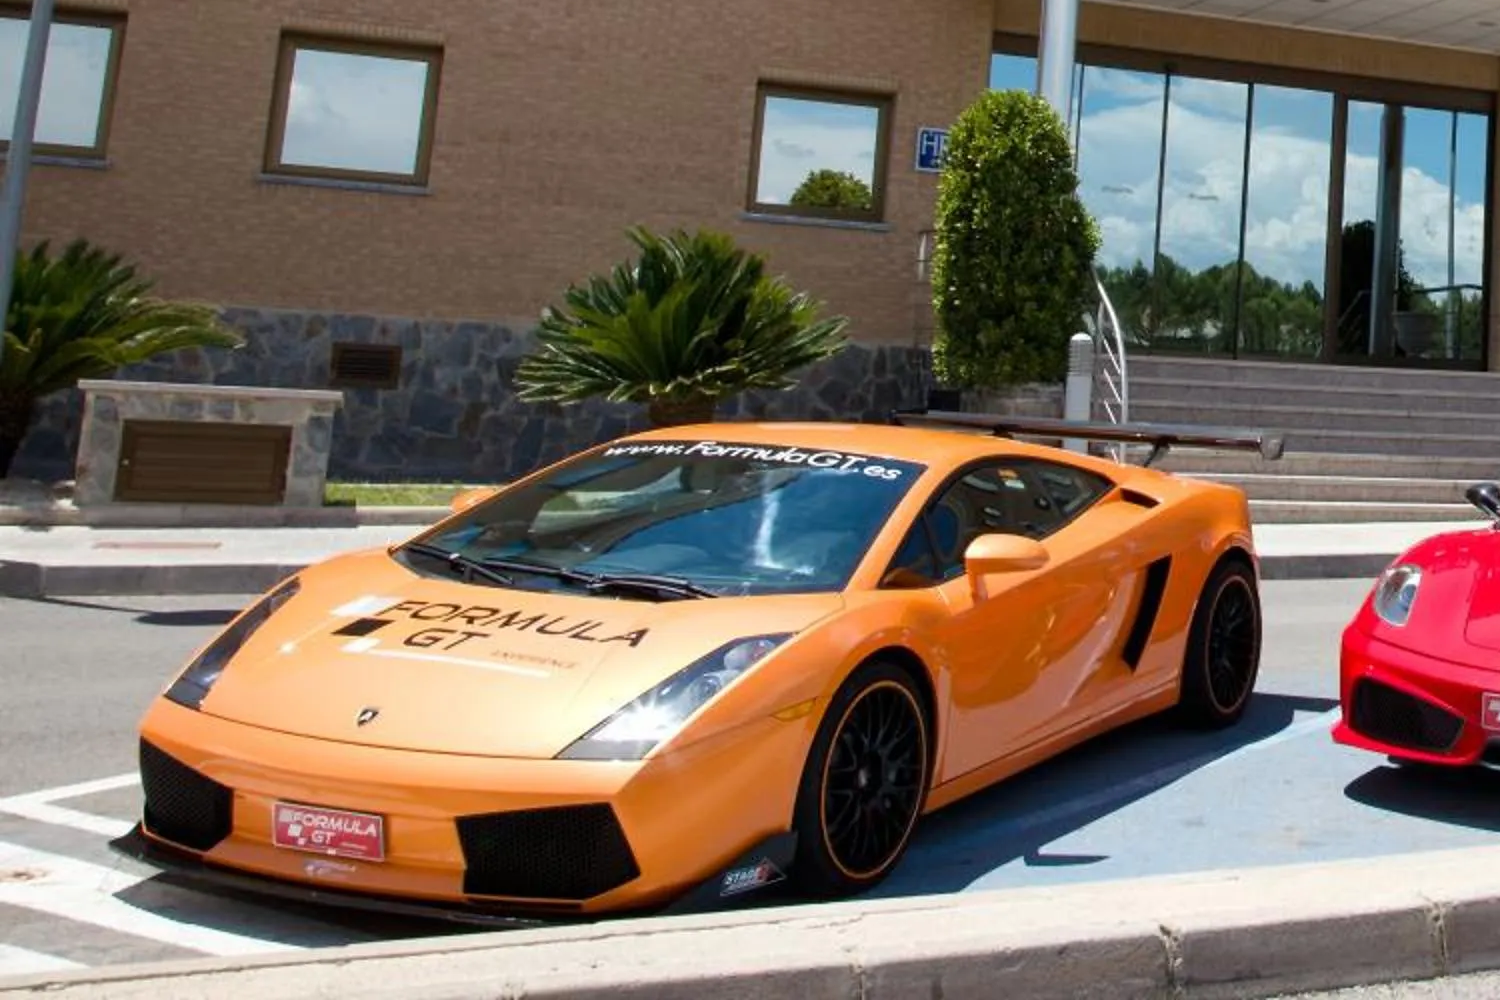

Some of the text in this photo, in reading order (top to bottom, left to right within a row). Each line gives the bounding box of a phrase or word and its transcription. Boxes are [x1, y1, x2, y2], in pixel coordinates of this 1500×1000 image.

[375, 600, 651, 649] FORMULA
[403, 628, 491, 650] GT
[294, 812, 377, 837] FORMULA
[312, 830, 336, 844] GT
